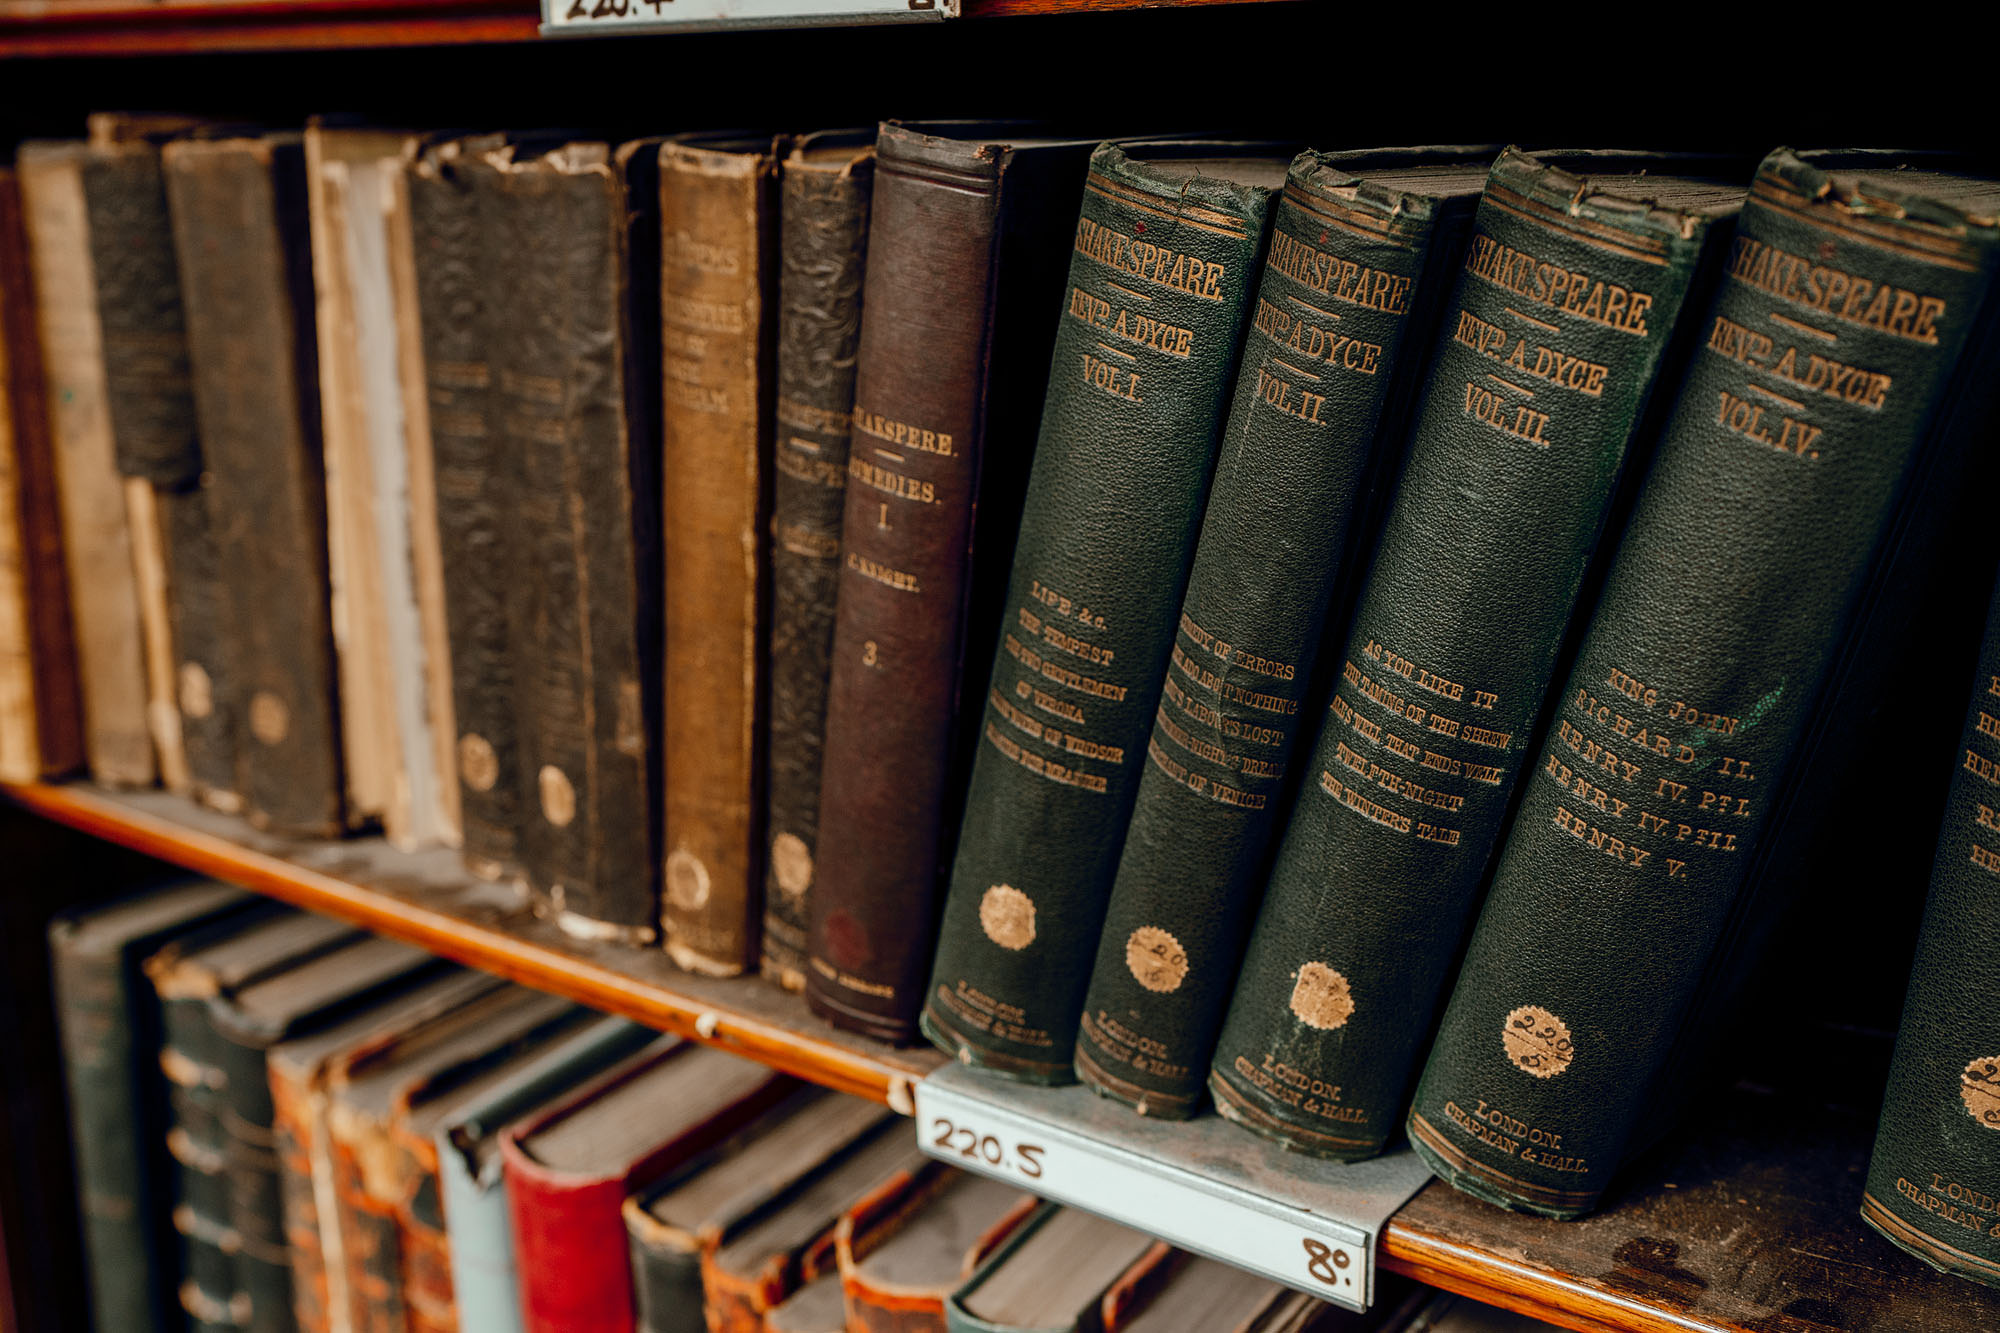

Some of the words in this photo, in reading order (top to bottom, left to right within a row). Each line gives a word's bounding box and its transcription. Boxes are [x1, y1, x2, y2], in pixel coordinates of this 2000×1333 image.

[1043, 625, 1115, 667] TEMPEST
[1214, 640, 1232, 660] OF
[1232, 650, 1296, 680] ERRORS
[1041, 661, 1129, 702] GENTLEMEN
[1232, 687, 1298, 715] NOTHING
[1363, 639, 1383, 661] AS
[1380, 650, 1415, 679] YOU
[1415, 668, 1464, 701] LIKE
[1471, 690, 1499, 710] IT
[1343, 660, 1361, 687] THE
[1359, 675, 1405, 714] TAMING
[1406, 704, 1426, 726] OF
[1428, 713, 1460, 738] THE
[1460, 725, 1512, 750] SHREW
[1576, 688, 1696, 764] RICHARD
[1607, 668, 1657, 708] KING
[1669, 701, 1739, 735] JOHN
[1241, 724, 1285, 746] LOST
[1383, 733, 1420, 761] THAT
[1420, 750, 1461, 776] ENDS
[1463, 762, 1503, 785] WELL
[1560, 720, 1641, 782] HENRY
[1188, 773, 1208, 793] OF
[1211, 782, 1267, 809] VENICE
[1545, 754, 1629, 817] HENRY
[1416, 822, 1461, 846] TALE
[1556, 806, 1651, 866] HENRY
[1303, 1098, 1320, 1114] &
[1444, 1100, 1520, 1155] CHAPMAN
[1520, 1147, 1538, 1163] &
[1538, 1151, 1589, 1173] HALL.
[1896, 1177, 1986, 1232] CHAPMAN
